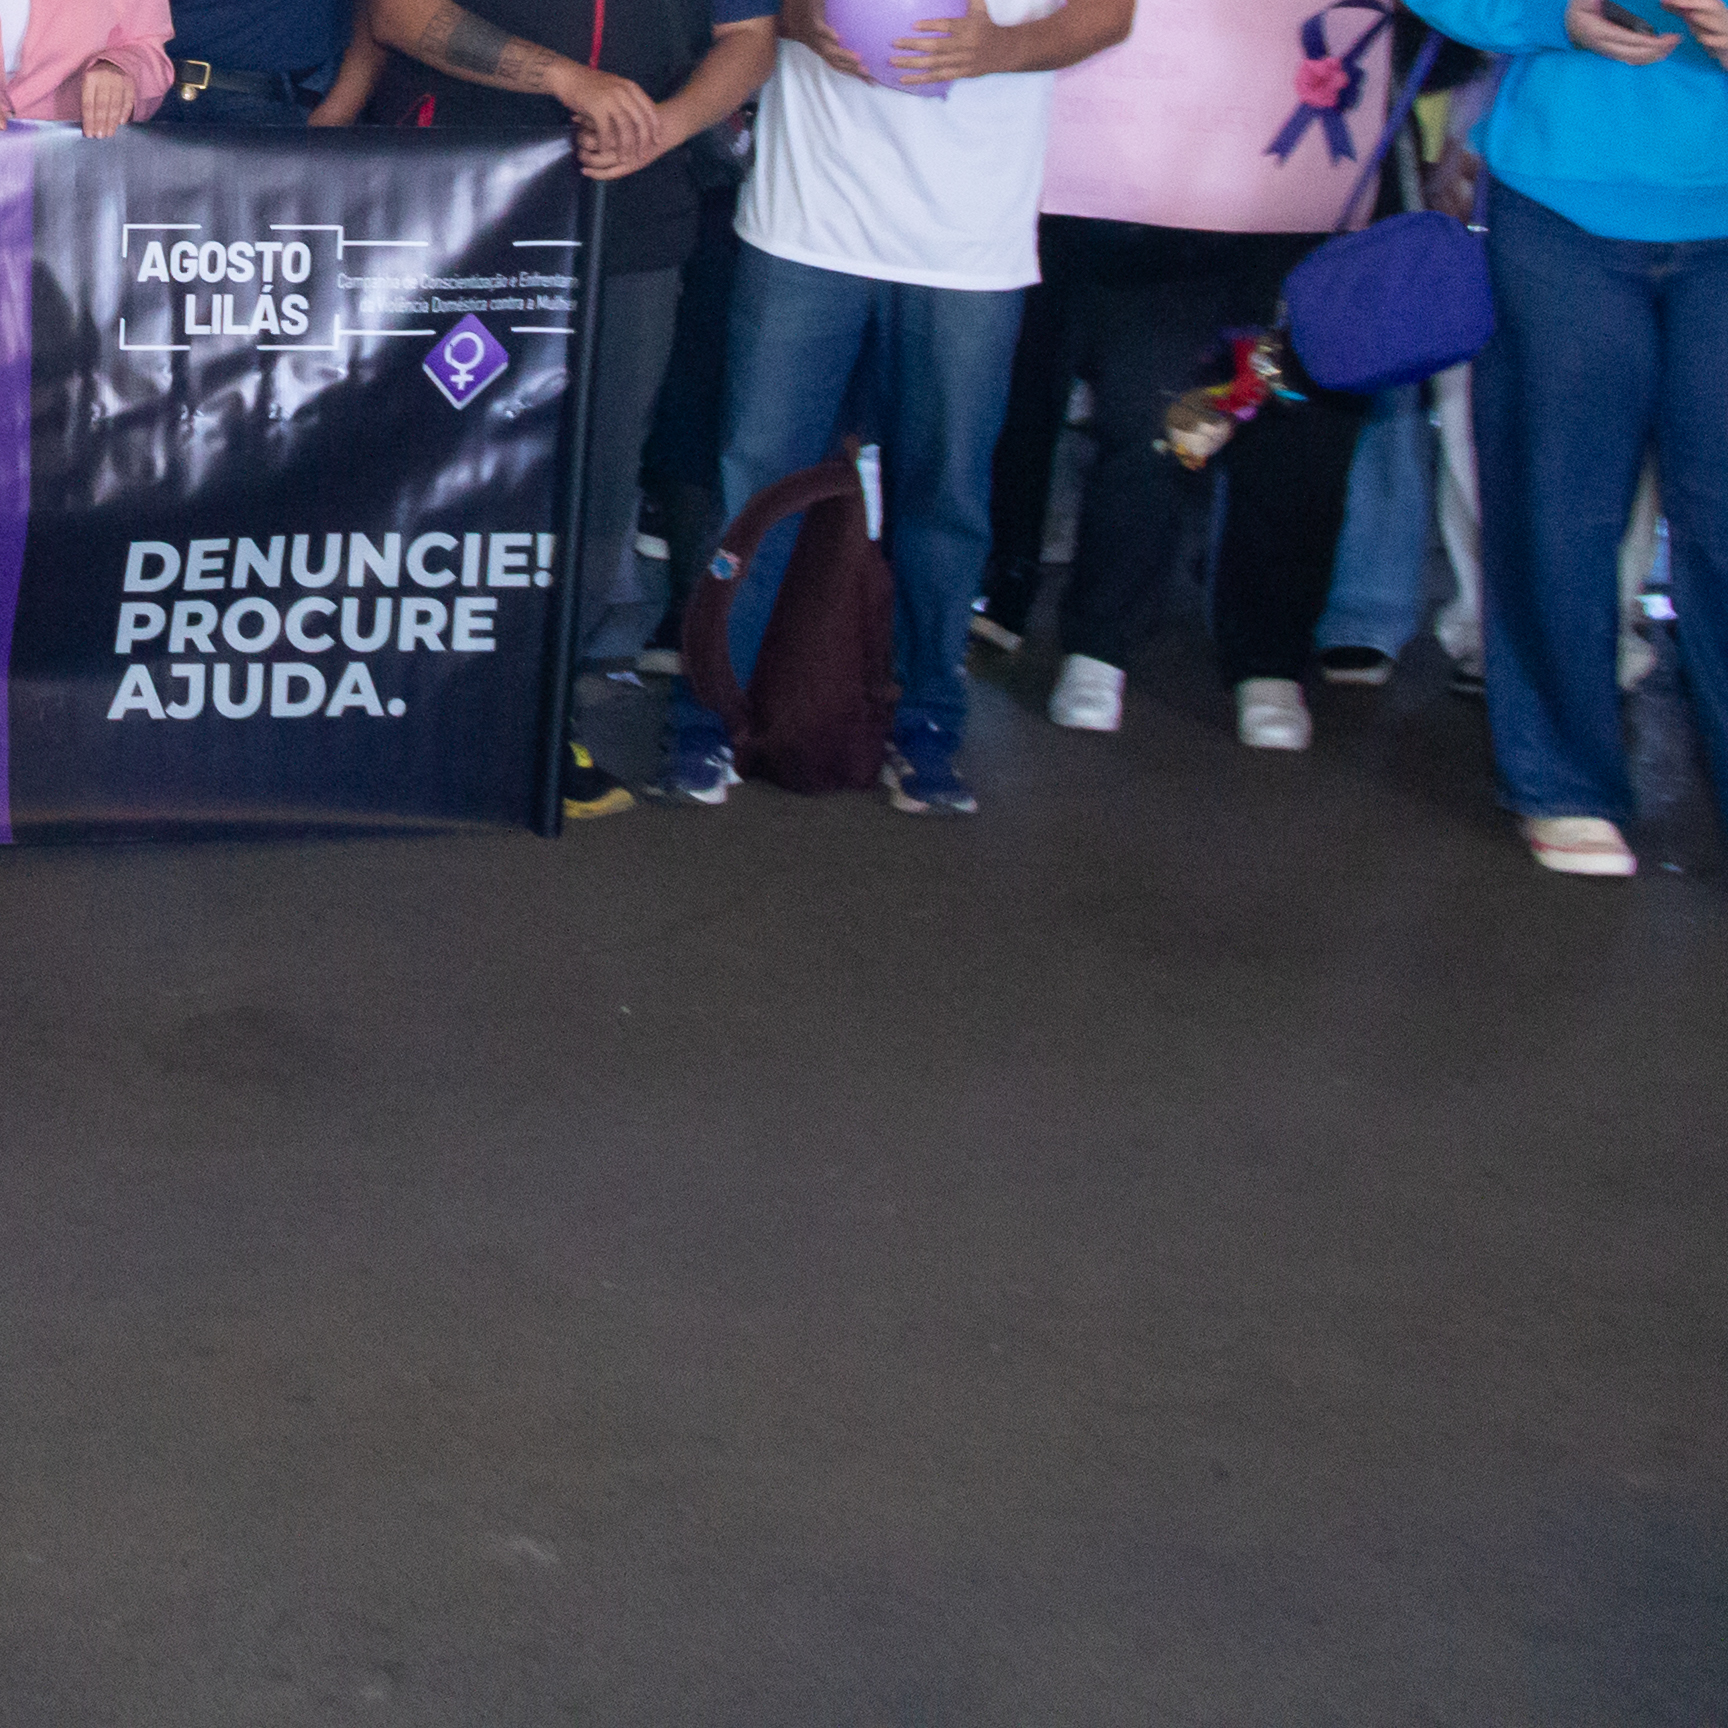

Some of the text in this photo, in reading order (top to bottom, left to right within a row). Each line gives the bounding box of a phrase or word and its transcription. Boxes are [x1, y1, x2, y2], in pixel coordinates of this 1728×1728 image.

[137, 240, 312, 284] AGOSTO
[184, 285, 311, 336] LILÁS
[122, 531, 557, 592] DENUNCIE!
[114, 596, 499, 654] PROCURE
[106, 661, 407, 721] AJUDA.
